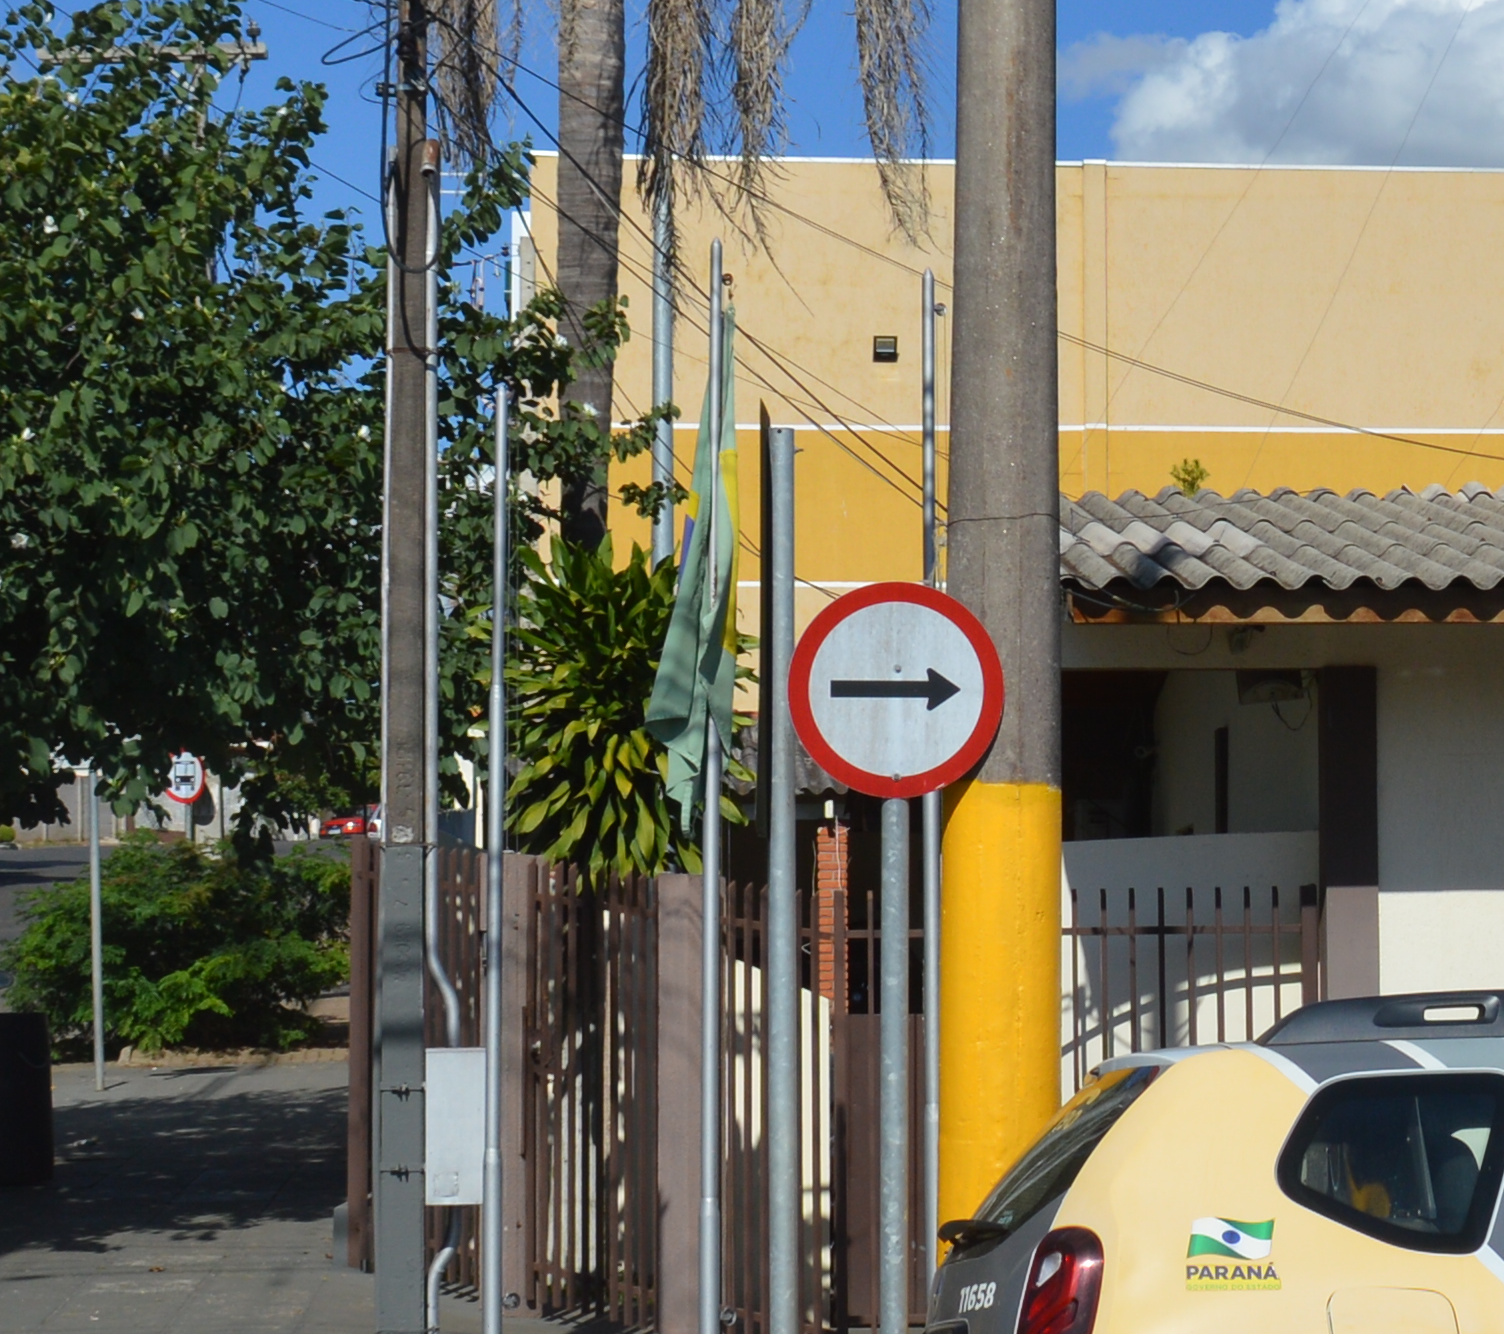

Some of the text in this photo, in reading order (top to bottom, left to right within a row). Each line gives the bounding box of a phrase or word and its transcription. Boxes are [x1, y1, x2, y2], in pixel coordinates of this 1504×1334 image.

[1186, 1261, 1279, 1280] PARANÁ
[1187, 1283, 1281, 1291] GOVERNO DO ESTADO
[959, 1281, 997, 1314] 11658
